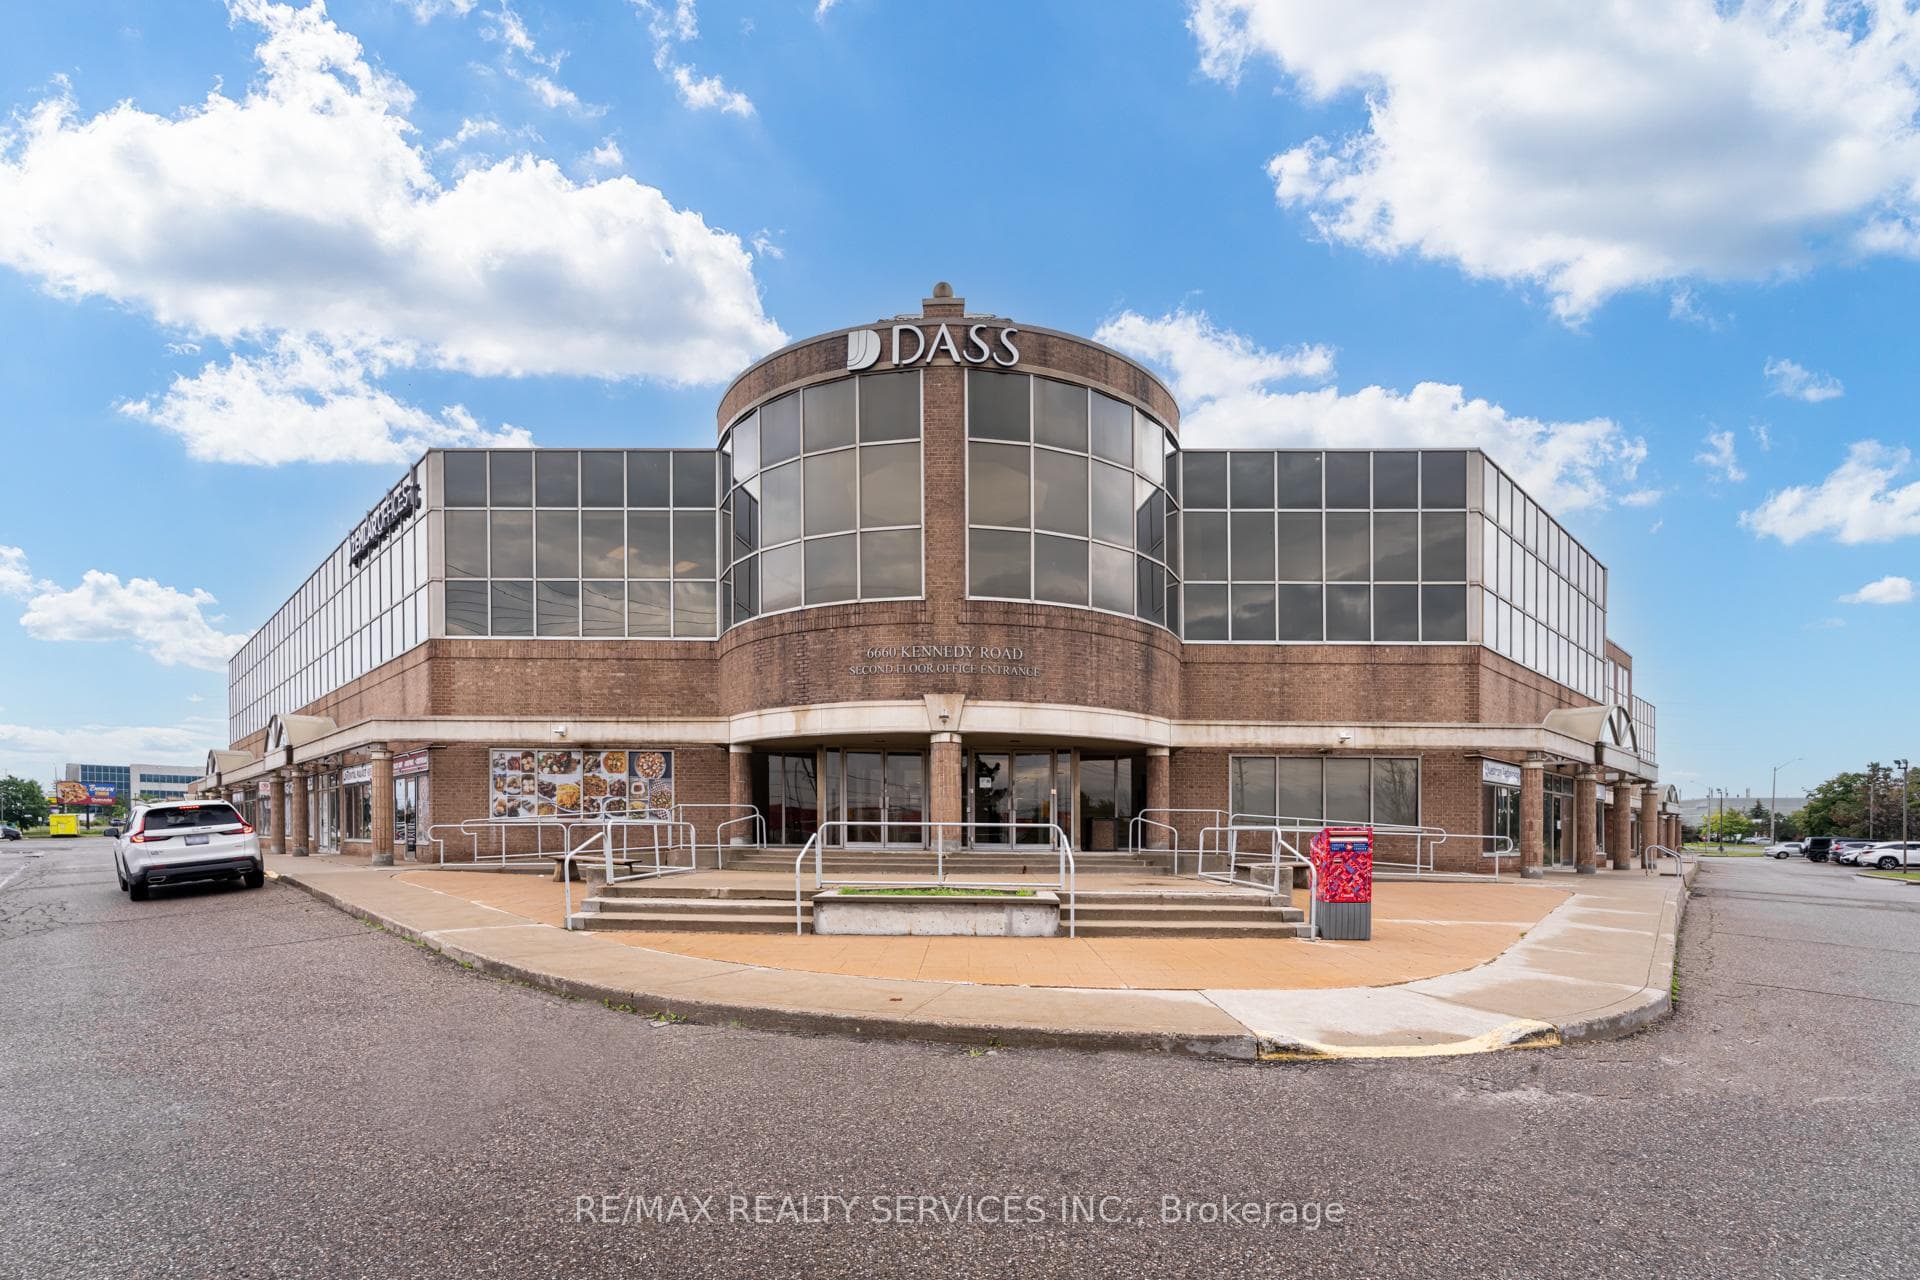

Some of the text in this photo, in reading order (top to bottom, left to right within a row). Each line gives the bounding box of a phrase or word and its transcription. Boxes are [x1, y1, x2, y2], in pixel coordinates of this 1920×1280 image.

[891, 323, 1020, 368] DASS
[867, 645, 1023, 660] 6660 KENNEDY ROAD
[849, 664, 1041, 677] SECOND FLOOR OFFICE ENTRANCE
